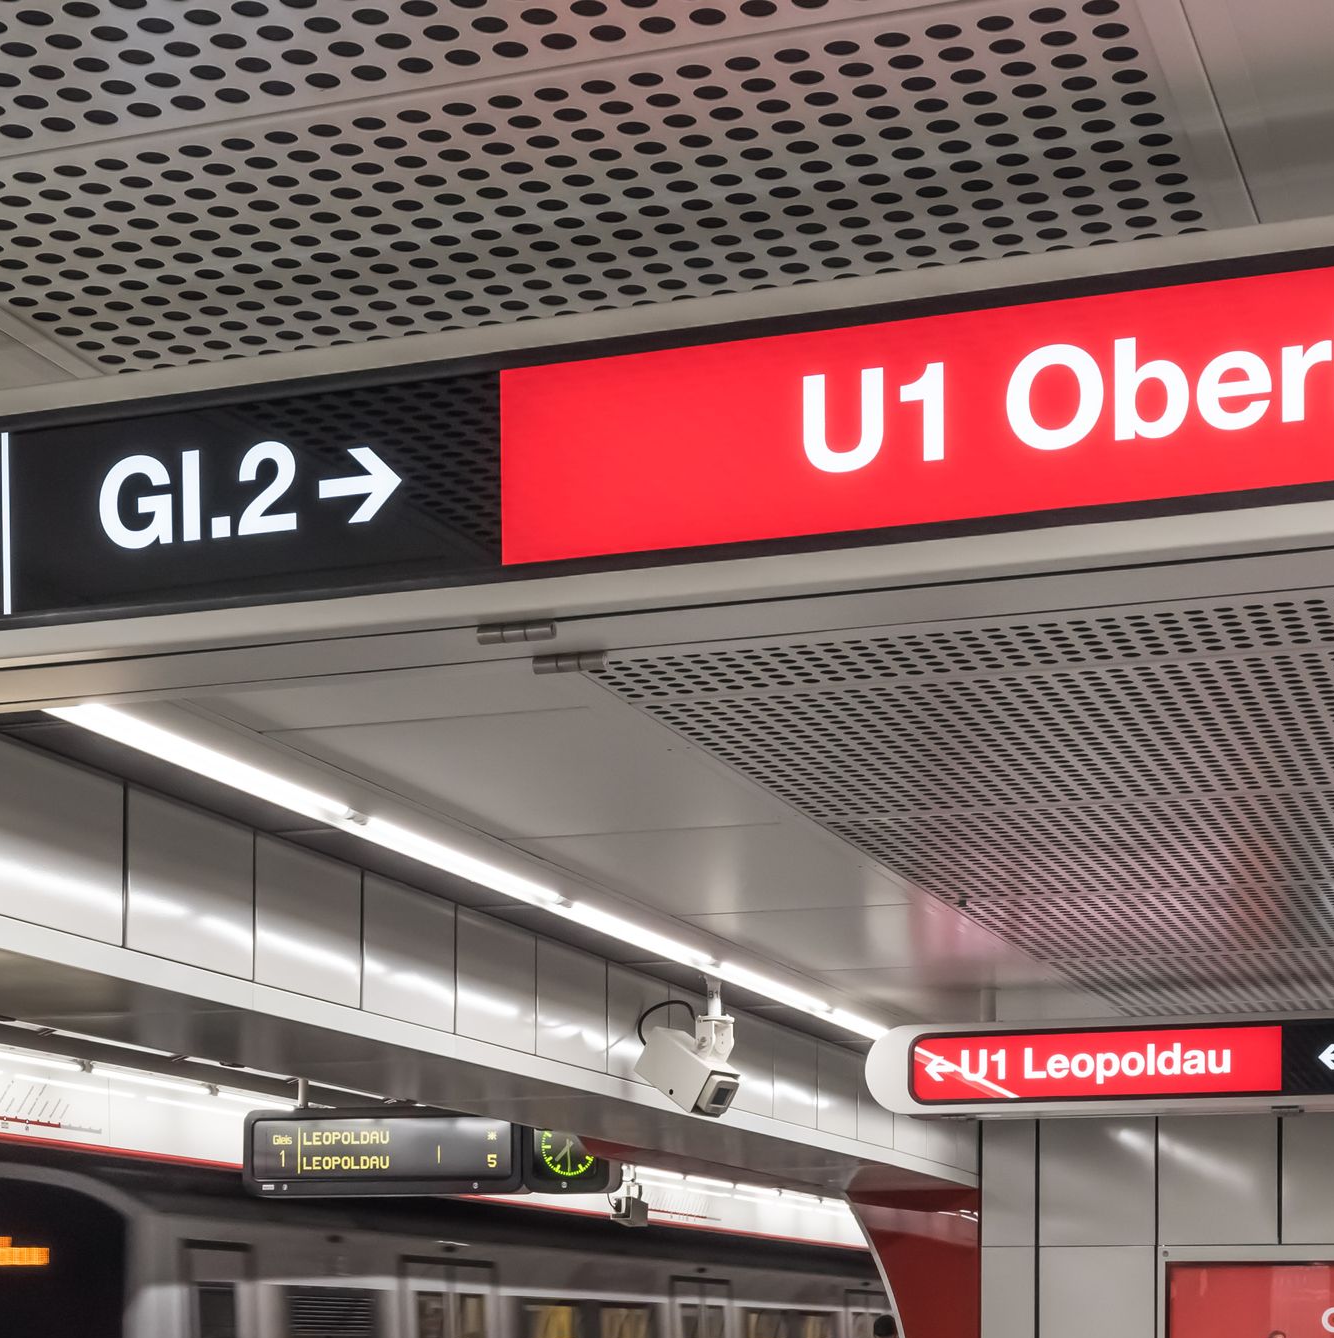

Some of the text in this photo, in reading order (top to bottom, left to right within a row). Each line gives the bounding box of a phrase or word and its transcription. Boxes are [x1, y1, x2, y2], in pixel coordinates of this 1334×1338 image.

[801, 361, 946, 474] U1
[98, 439, 298, 550] Gl.2
[960, 1042, 1231, 1085] U1 Leopoldau
[272, 1134, 293, 1146] Gleis
[302, 1131, 390, 1146] LEOPOLDAU
[279, 1149, 286, 1168] 1
[302, 1154, 498, 1171] LEOPOLDAU 5
